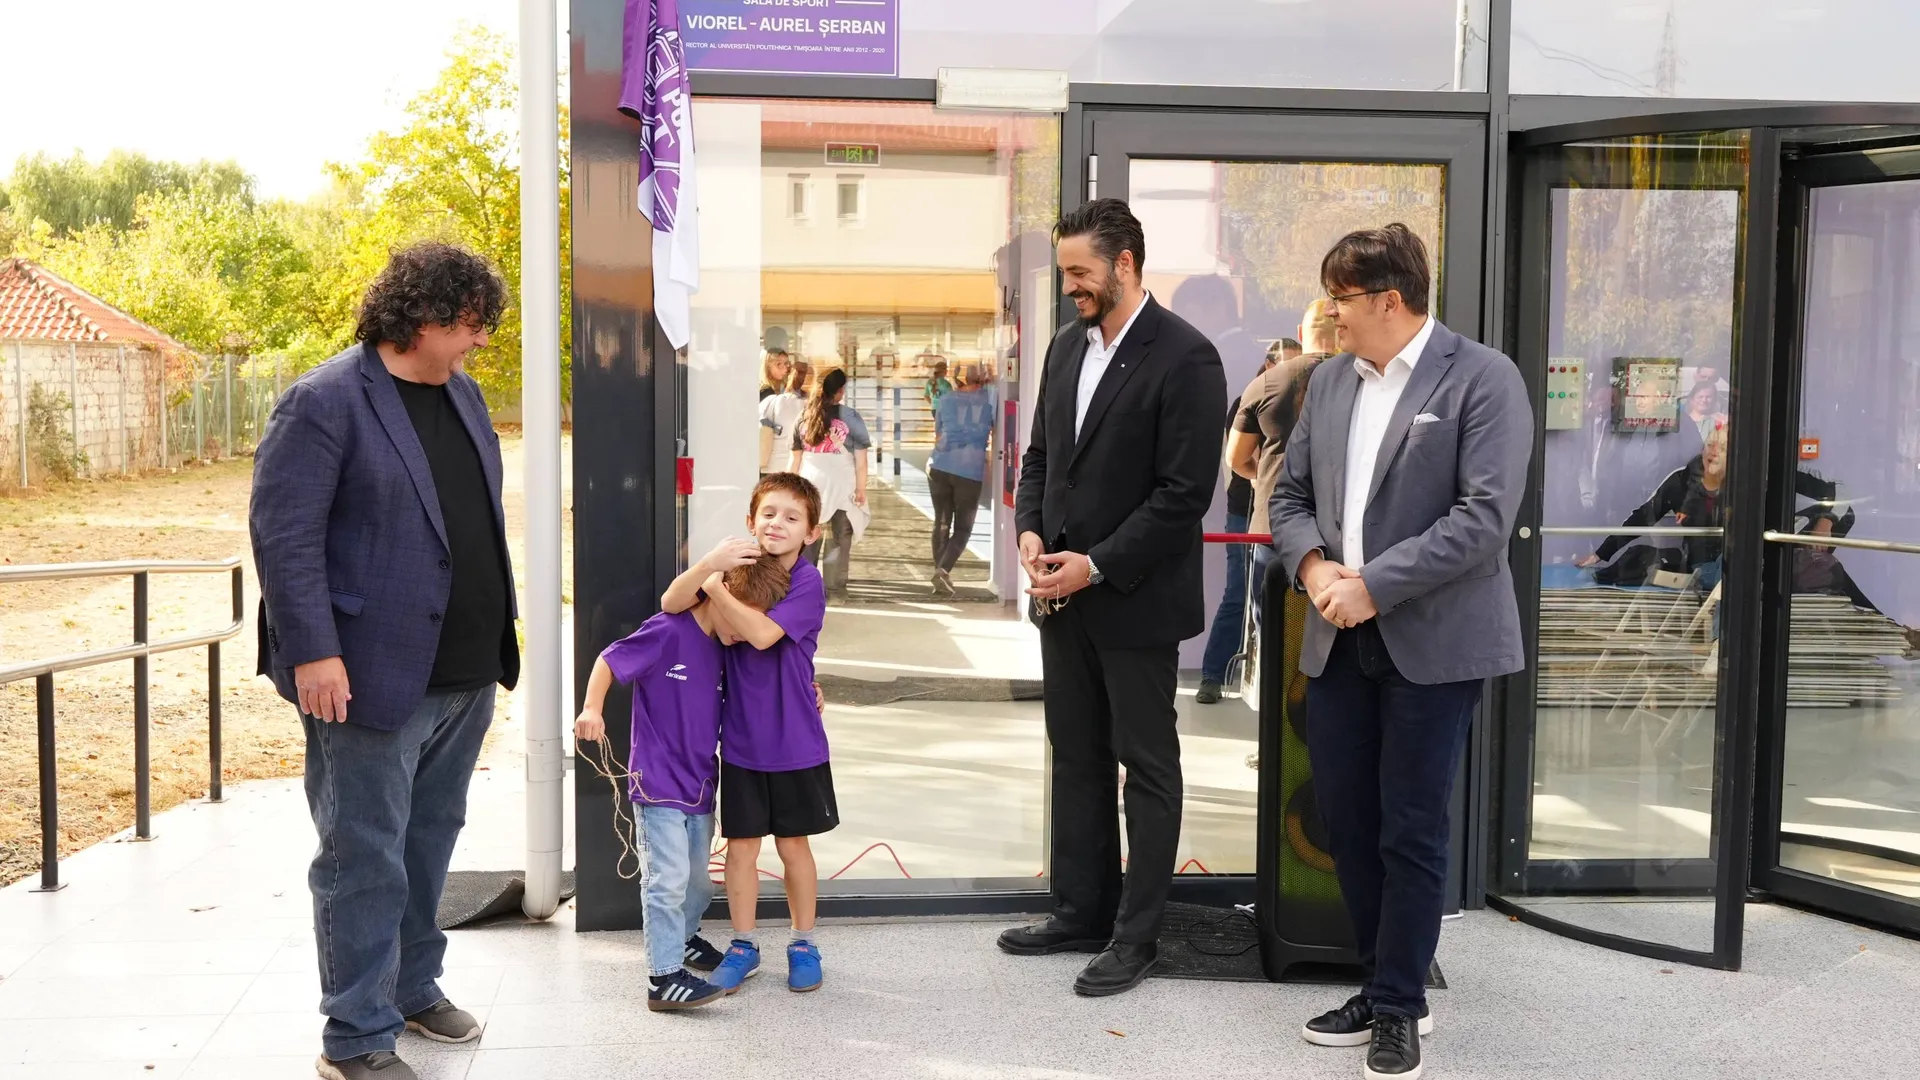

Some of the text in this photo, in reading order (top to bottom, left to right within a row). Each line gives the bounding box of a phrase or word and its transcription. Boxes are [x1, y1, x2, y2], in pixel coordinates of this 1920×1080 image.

[686, 14, 747, 31] VIOREL
[818, 19, 886, 38] ȘERBAN
[824, 45, 841, 53] ÎNTRE
